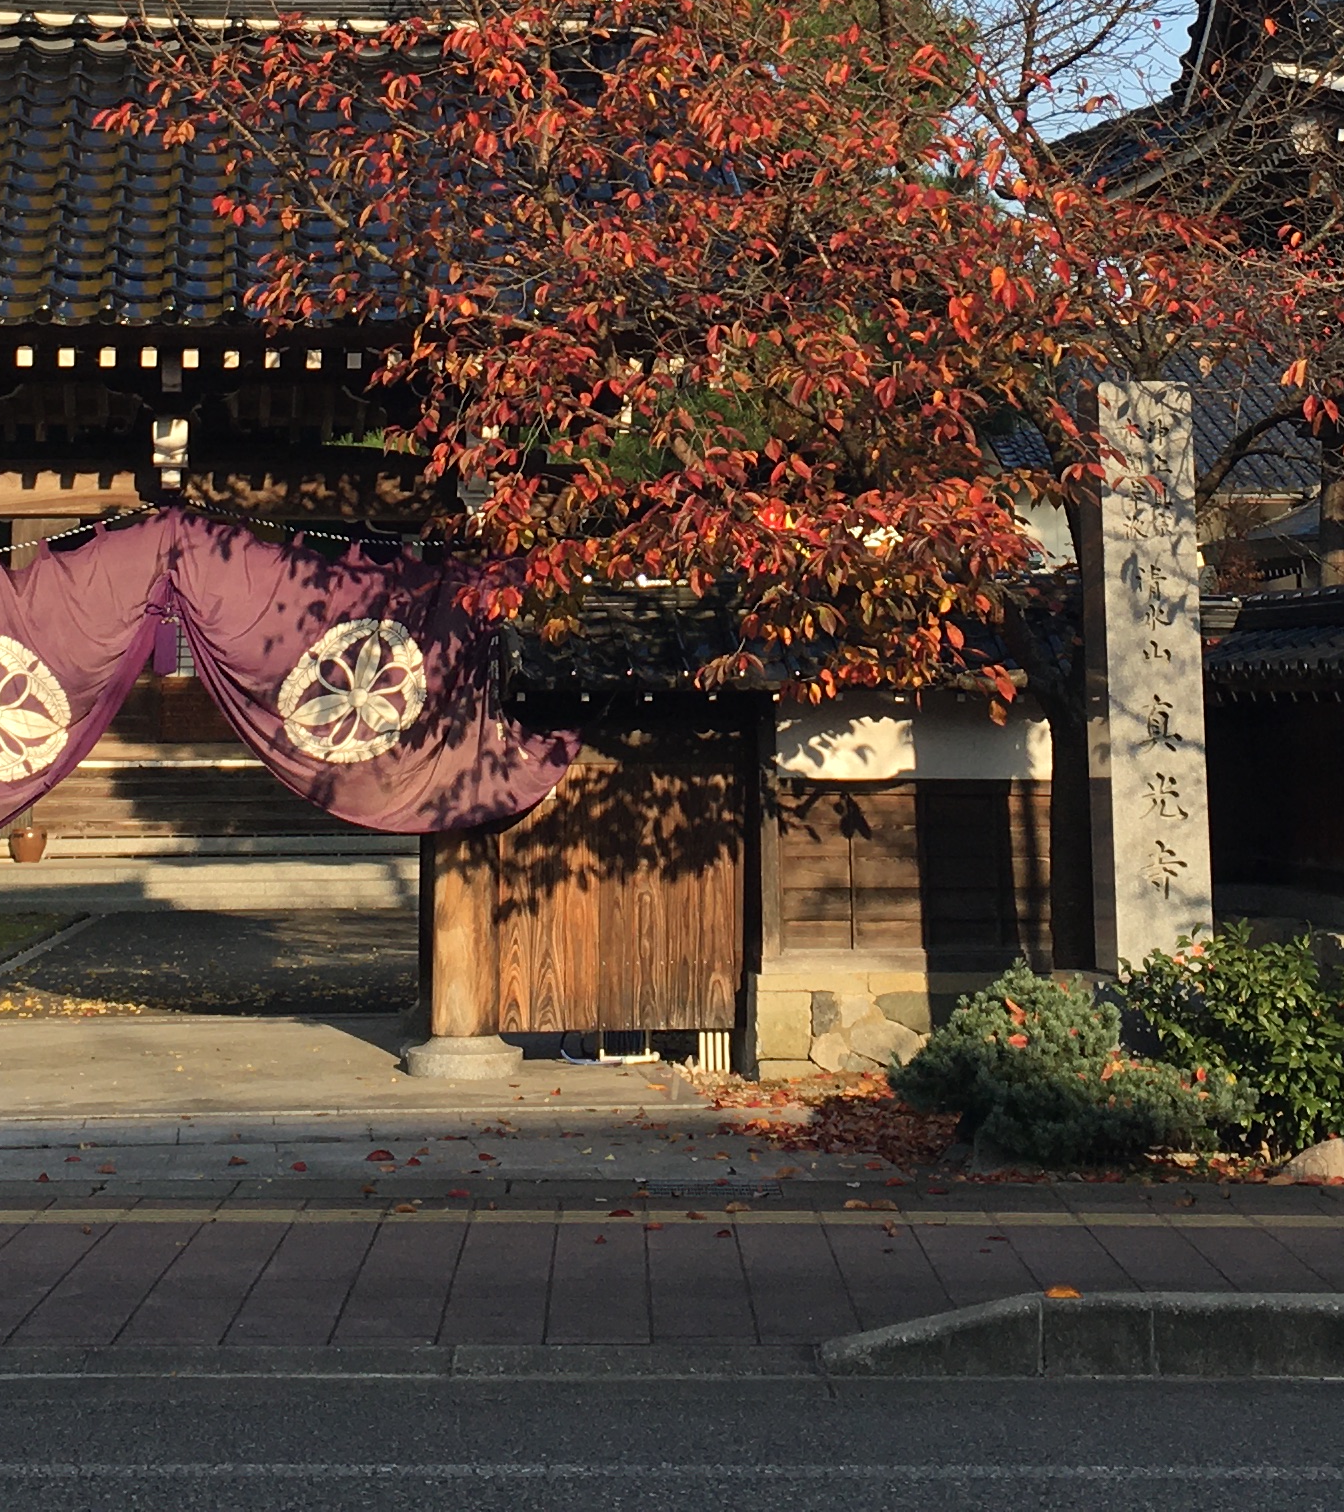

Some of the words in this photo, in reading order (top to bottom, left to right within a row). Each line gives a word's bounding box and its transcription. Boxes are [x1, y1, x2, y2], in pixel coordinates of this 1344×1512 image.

[1135, 564, 1172, 663] 清水山
[1139, 693, 1188, 900] 真光寺
